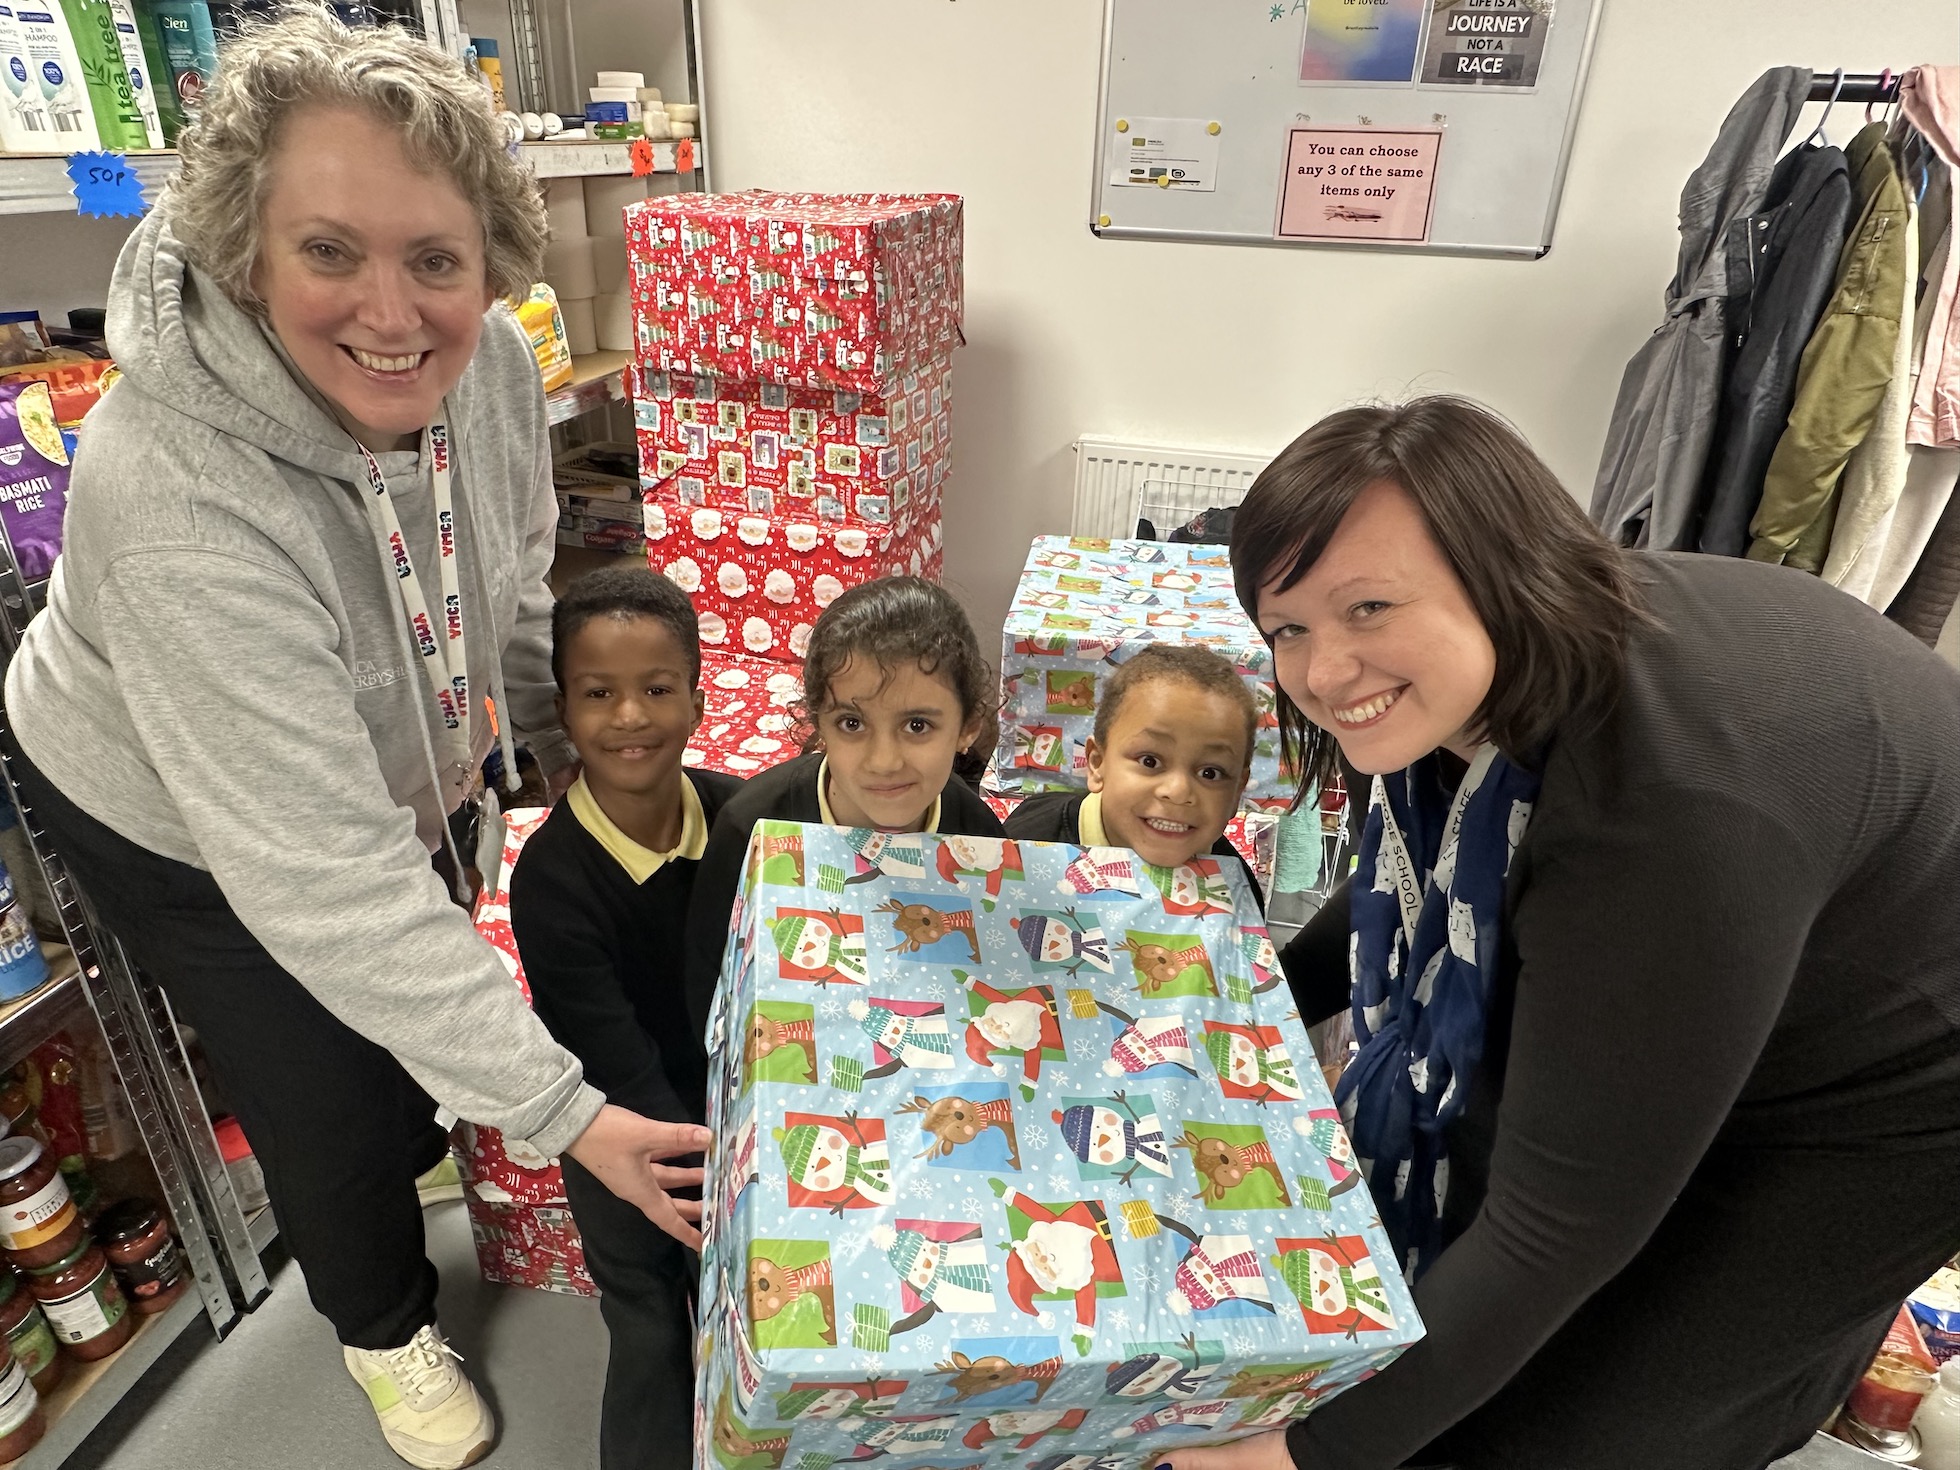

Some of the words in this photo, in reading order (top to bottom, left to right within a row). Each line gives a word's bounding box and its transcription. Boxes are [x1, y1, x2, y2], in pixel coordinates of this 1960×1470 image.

[98, 14, 120, 63] tree
[1448, 15, 1530, 33] JOURNEY
[1467, 39, 1492, 50] NOT
[1494, 40, 1504, 50] A
[1457, 57, 1504, 73] RACE
[114, 71, 132, 109] tea
[1309, 144, 1335, 155] You
[1340, 146, 1364, 156] can
[1370, 145, 1419, 157] choose
[1298, 166, 1323, 177] any
[1327, 165, 1336, 175] 3
[1341, 165, 1356, 176] of
[1360, 166, 1382, 176] the
[1387, 168, 1424, 178] same
[1320, 184, 1360, 196] items
[1364, 186, 1395, 200] only
[431, 425, 448, 473] YMCA
[0, 476, 52, 502] BASMATI
[15, 495, 45, 514] RICE
[439, 511, 454, 558] YMCA
[389, 532, 411, 579] YMCA
[414, 612, 436, 657] YMCA
[446, 594, 462, 640] YMCA
[437, 688, 459, 729] YMCA
[1452, 788, 1471, 835] STAFF
[1393, 846, 1418, 915] SCHOOL
